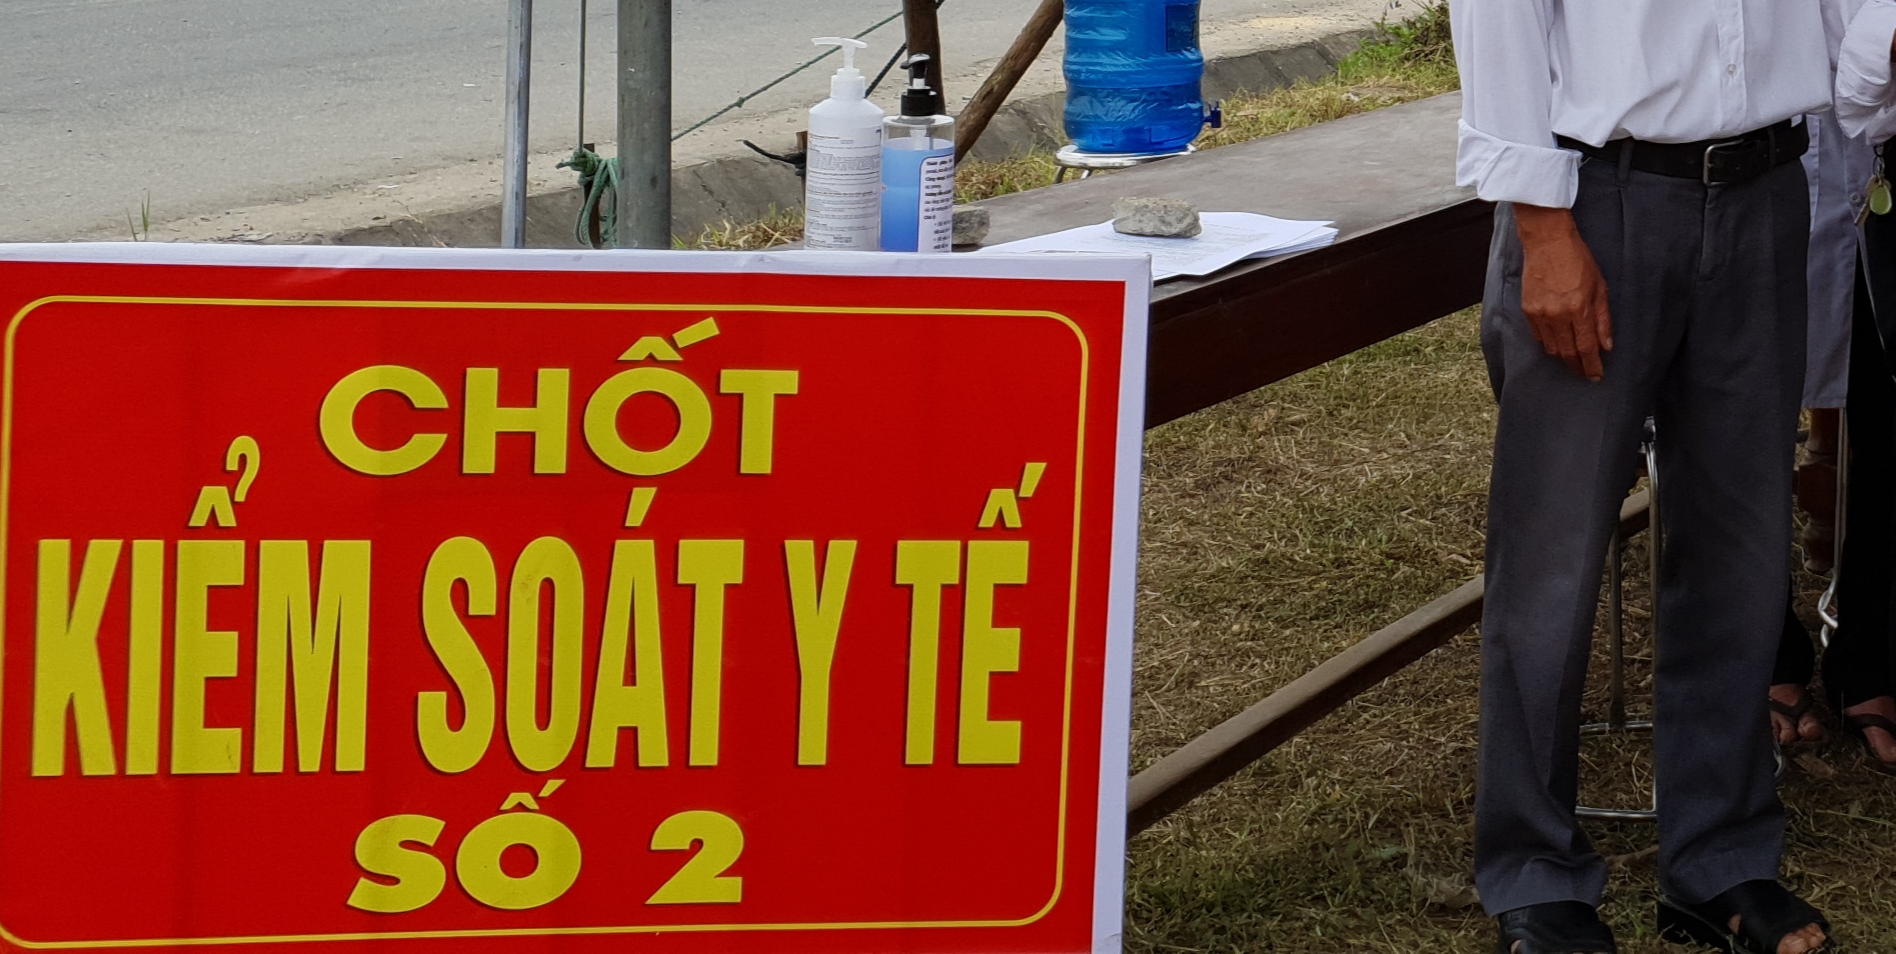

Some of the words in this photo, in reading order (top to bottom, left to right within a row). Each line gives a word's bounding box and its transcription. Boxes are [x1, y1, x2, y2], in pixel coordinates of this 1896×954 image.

[319, 316, 800, 477] CHỐT
[31, 435, 372, 777] KIỂM
[416, 487, 745, 775] SOÁT
[784, 540, 858, 767] Y
[894, 462, 1047, 767] TẾ
[347, 779, 583, 915] SỐ
[645, 809, 746, 905] 2
